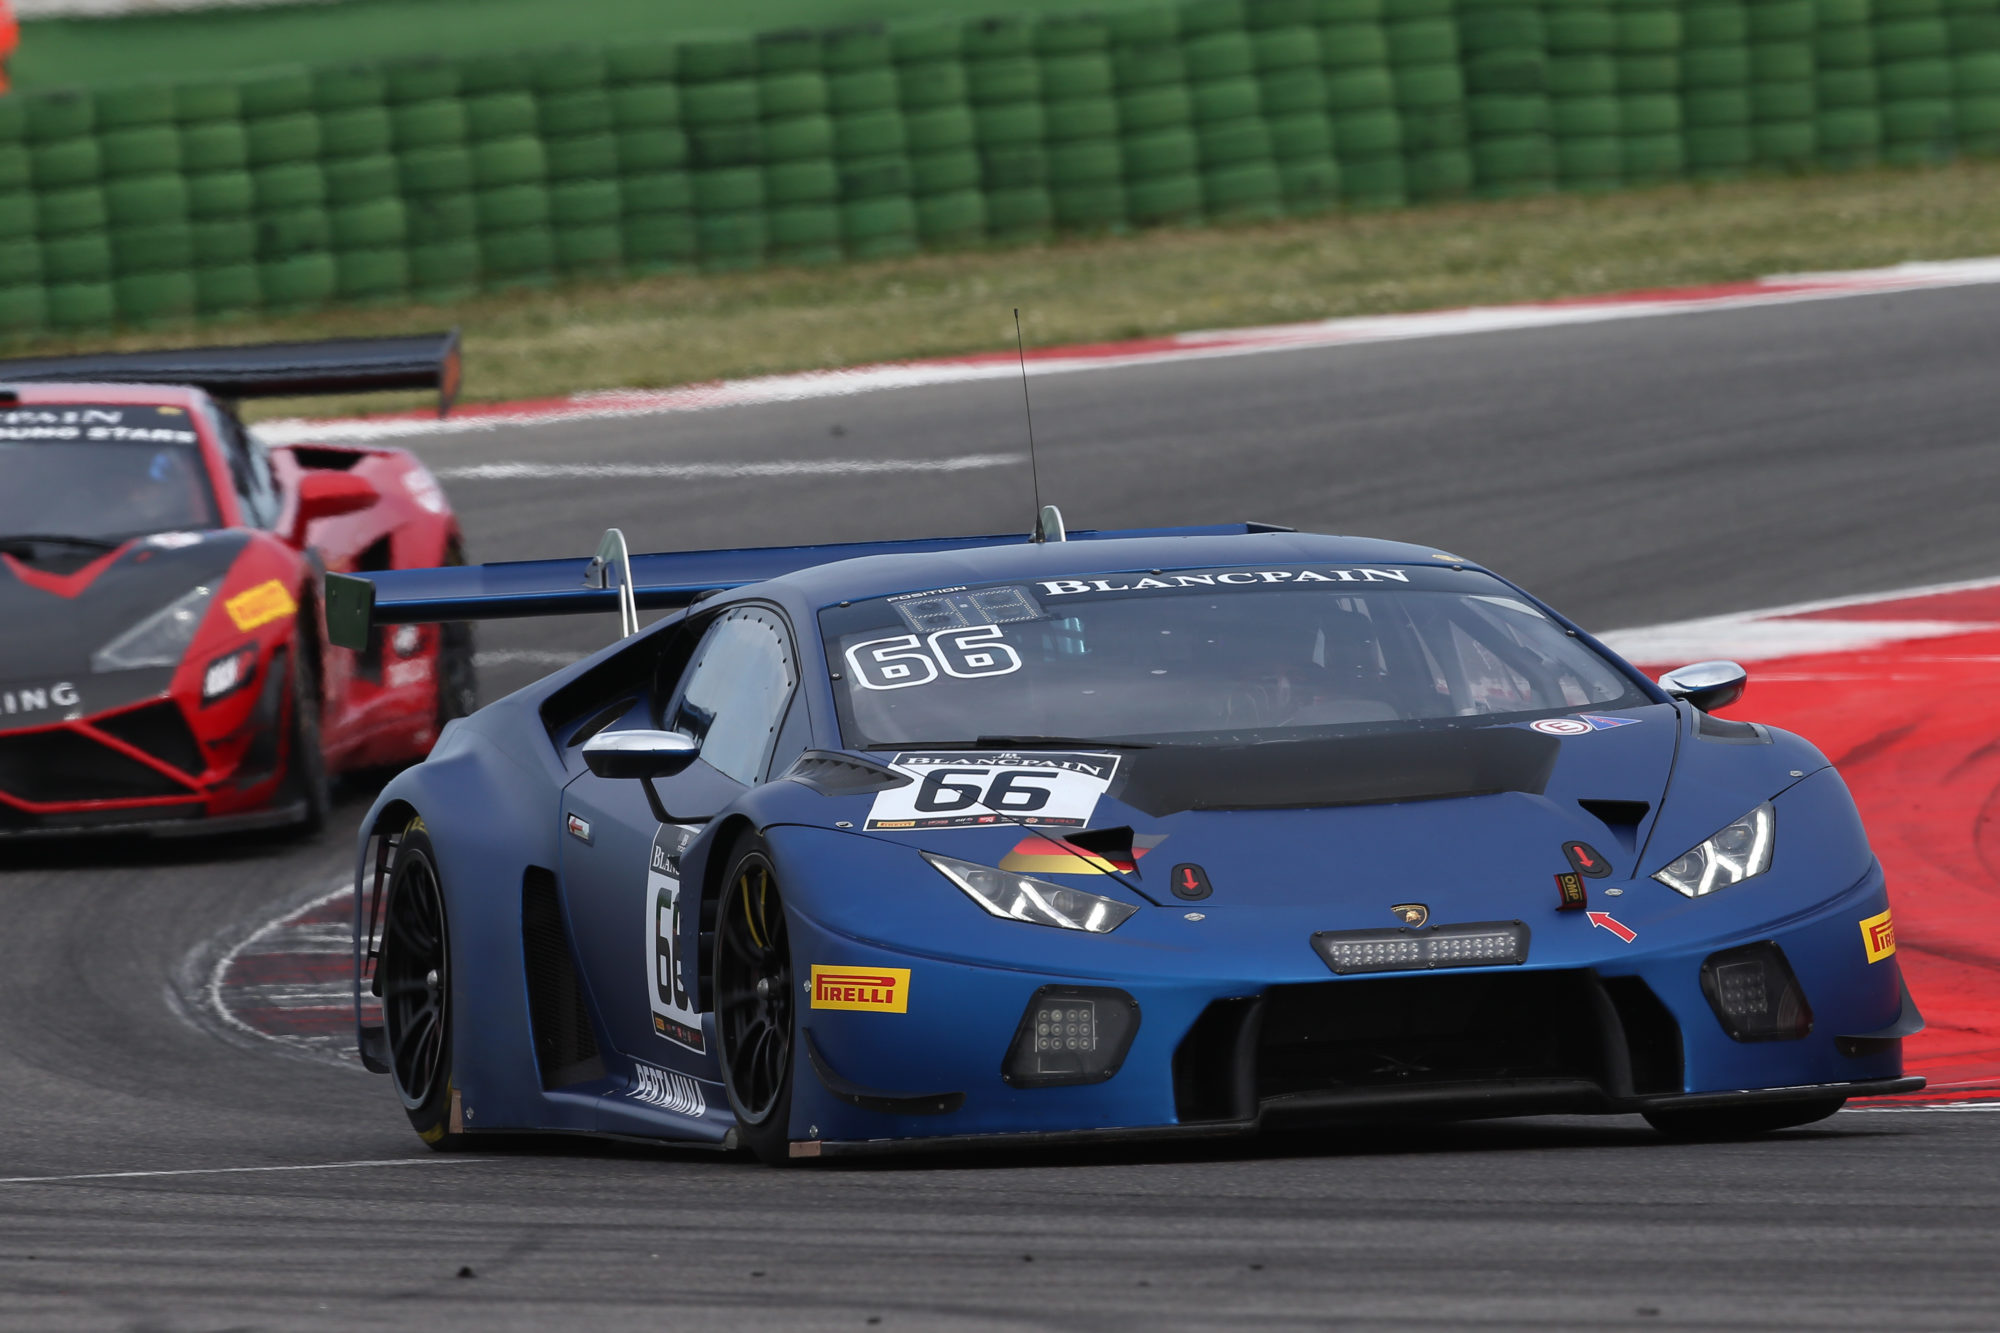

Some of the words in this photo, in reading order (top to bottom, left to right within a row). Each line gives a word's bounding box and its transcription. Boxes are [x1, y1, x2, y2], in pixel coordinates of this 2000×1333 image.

[86, 426, 196, 444] STARS
[886, 586, 967, 602] POSITION
[1036, 568, 1410, 596] BLANCPAIN
[845, 624, 1023, 690] 66
[906, 756, 1105, 777] BLANCPAIN
[914, 769, 1060, 813] 66
[652, 845, 680, 875] BLA
[1564, 875, 1580, 900] OMP
[816, 973, 896, 1004] PIRELLI
[625, 1063, 707, 1118] PERTAMINA
